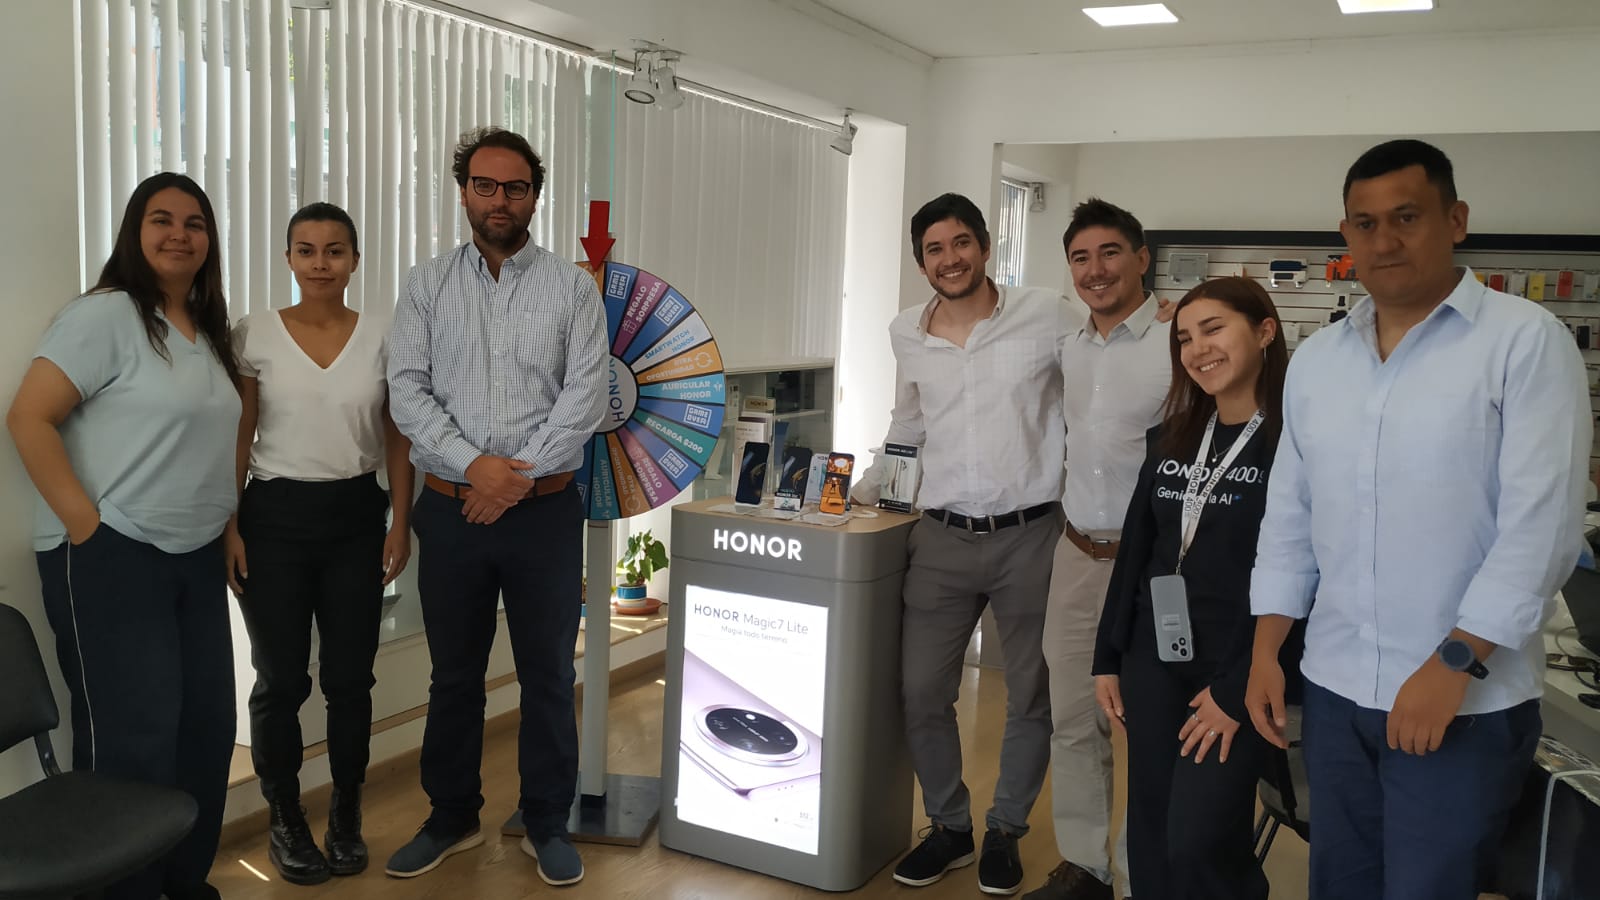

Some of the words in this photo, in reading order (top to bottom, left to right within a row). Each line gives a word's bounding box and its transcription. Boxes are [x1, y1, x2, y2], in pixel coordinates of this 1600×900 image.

[616, 275, 627, 296] OVER
[627, 285, 648, 318] REGALO
[635, 281, 662, 322] SORPRESA
[663, 304, 680, 323] OVER
[645, 329, 690, 360] SMARTWATCH
[671, 336, 695, 353] HONOR
[662, 381, 711, 391] AURICULAR
[680, 391, 711, 400] HONOR
[687, 413, 707, 425] OVER
[688, 407, 709, 418] GAME
[645, 418, 682, 443] RECARGA
[1246, 418, 1260, 433] 400
[643, 457, 662, 489] REGALO
[663, 458, 680, 475] OVER
[1157, 459, 1220, 483] ONO
[1225, 466, 1259, 483] 400
[1188, 461, 1205, 495] HONOR
[593, 477, 603, 508] HONOR
[600, 459, 612, 508] AURICULAR
[633, 462, 659, 503] SORPRESA
[1202, 465, 1226, 498] HONOR
[1157, 486, 1187, 501] Geni
[1218, 493, 1233, 505] AI
[1184, 496, 1193, 511] 400
[713, 528, 803, 561] HONOR
[694, 603, 739, 622] HONOR
[743, 613, 785, 631] Magic7
[787, 620, 809, 635] Lite
[721, 625, 743, 636] Magia
